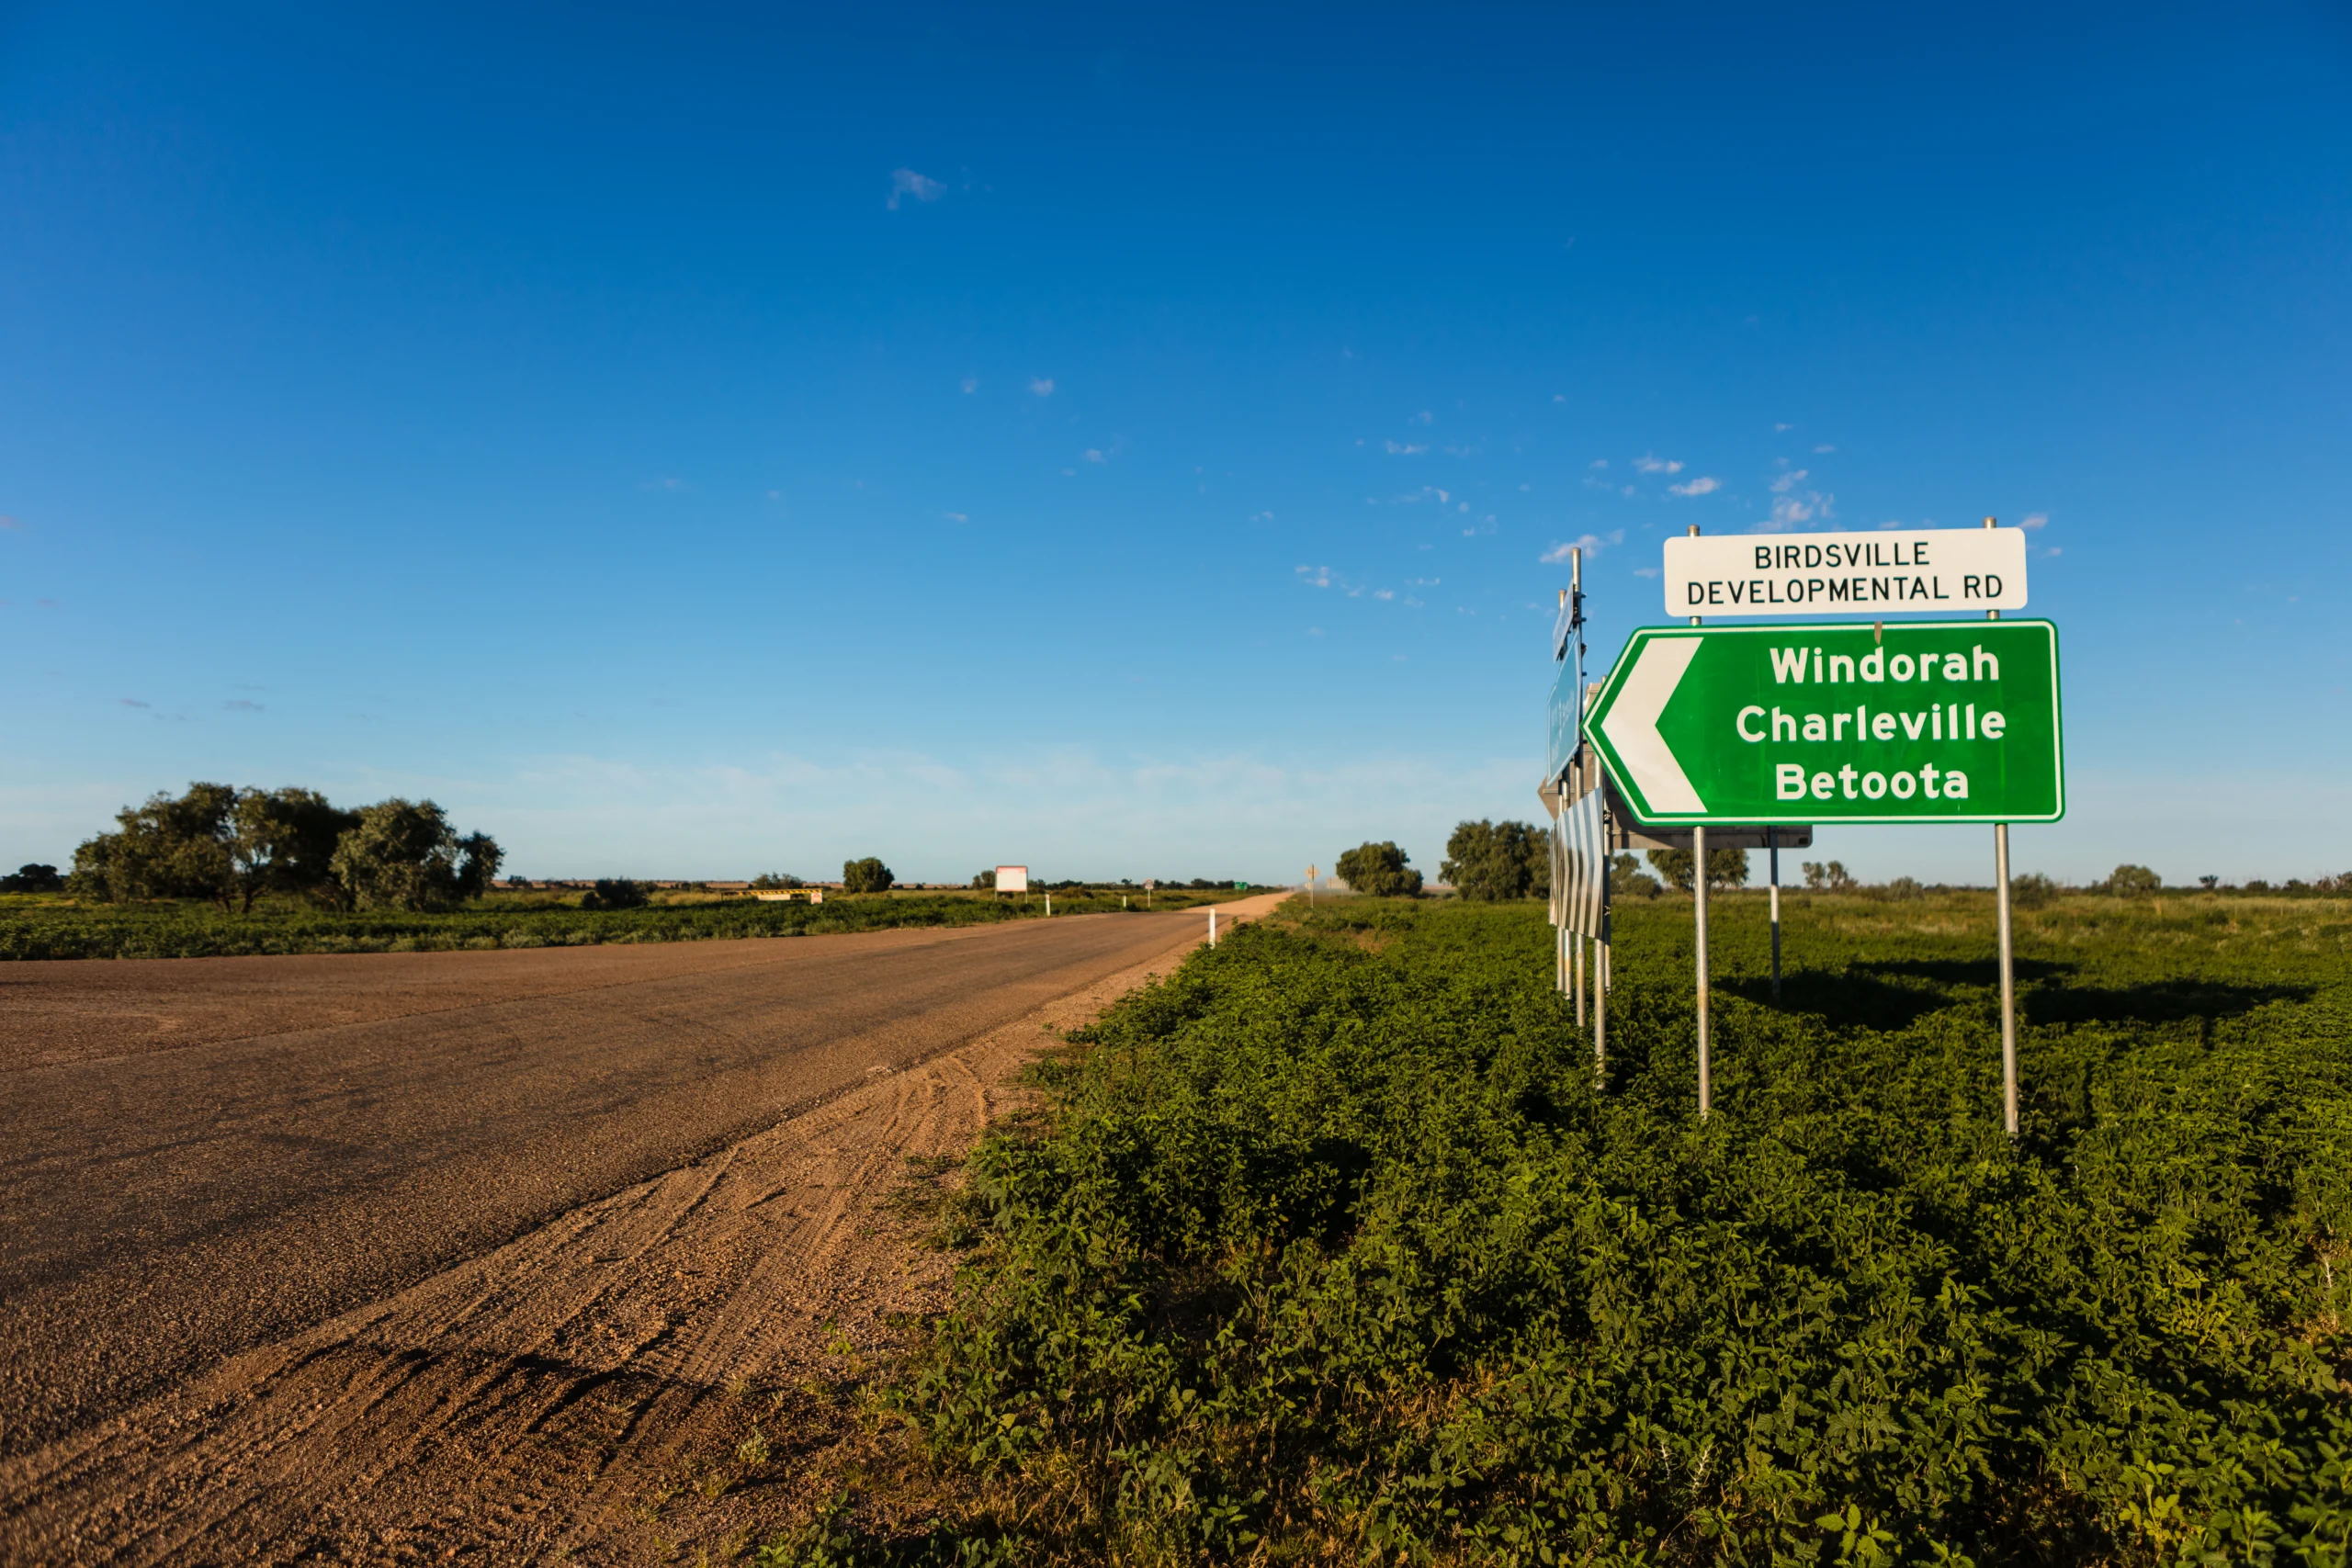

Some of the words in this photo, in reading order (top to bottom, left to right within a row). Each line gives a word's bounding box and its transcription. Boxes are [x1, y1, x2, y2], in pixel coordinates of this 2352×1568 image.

[1755, 542, 1930, 570] BIRDSVILLE
[1688, 577, 1950, 605] DEVELOPMENTAL
[1963, 574, 2003, 599] RD
[1770, 644, 1999, 683] Windorah
[1736, 703, 2007, 742] Charleville
[1776, 762, 1969, 800] Betoota
